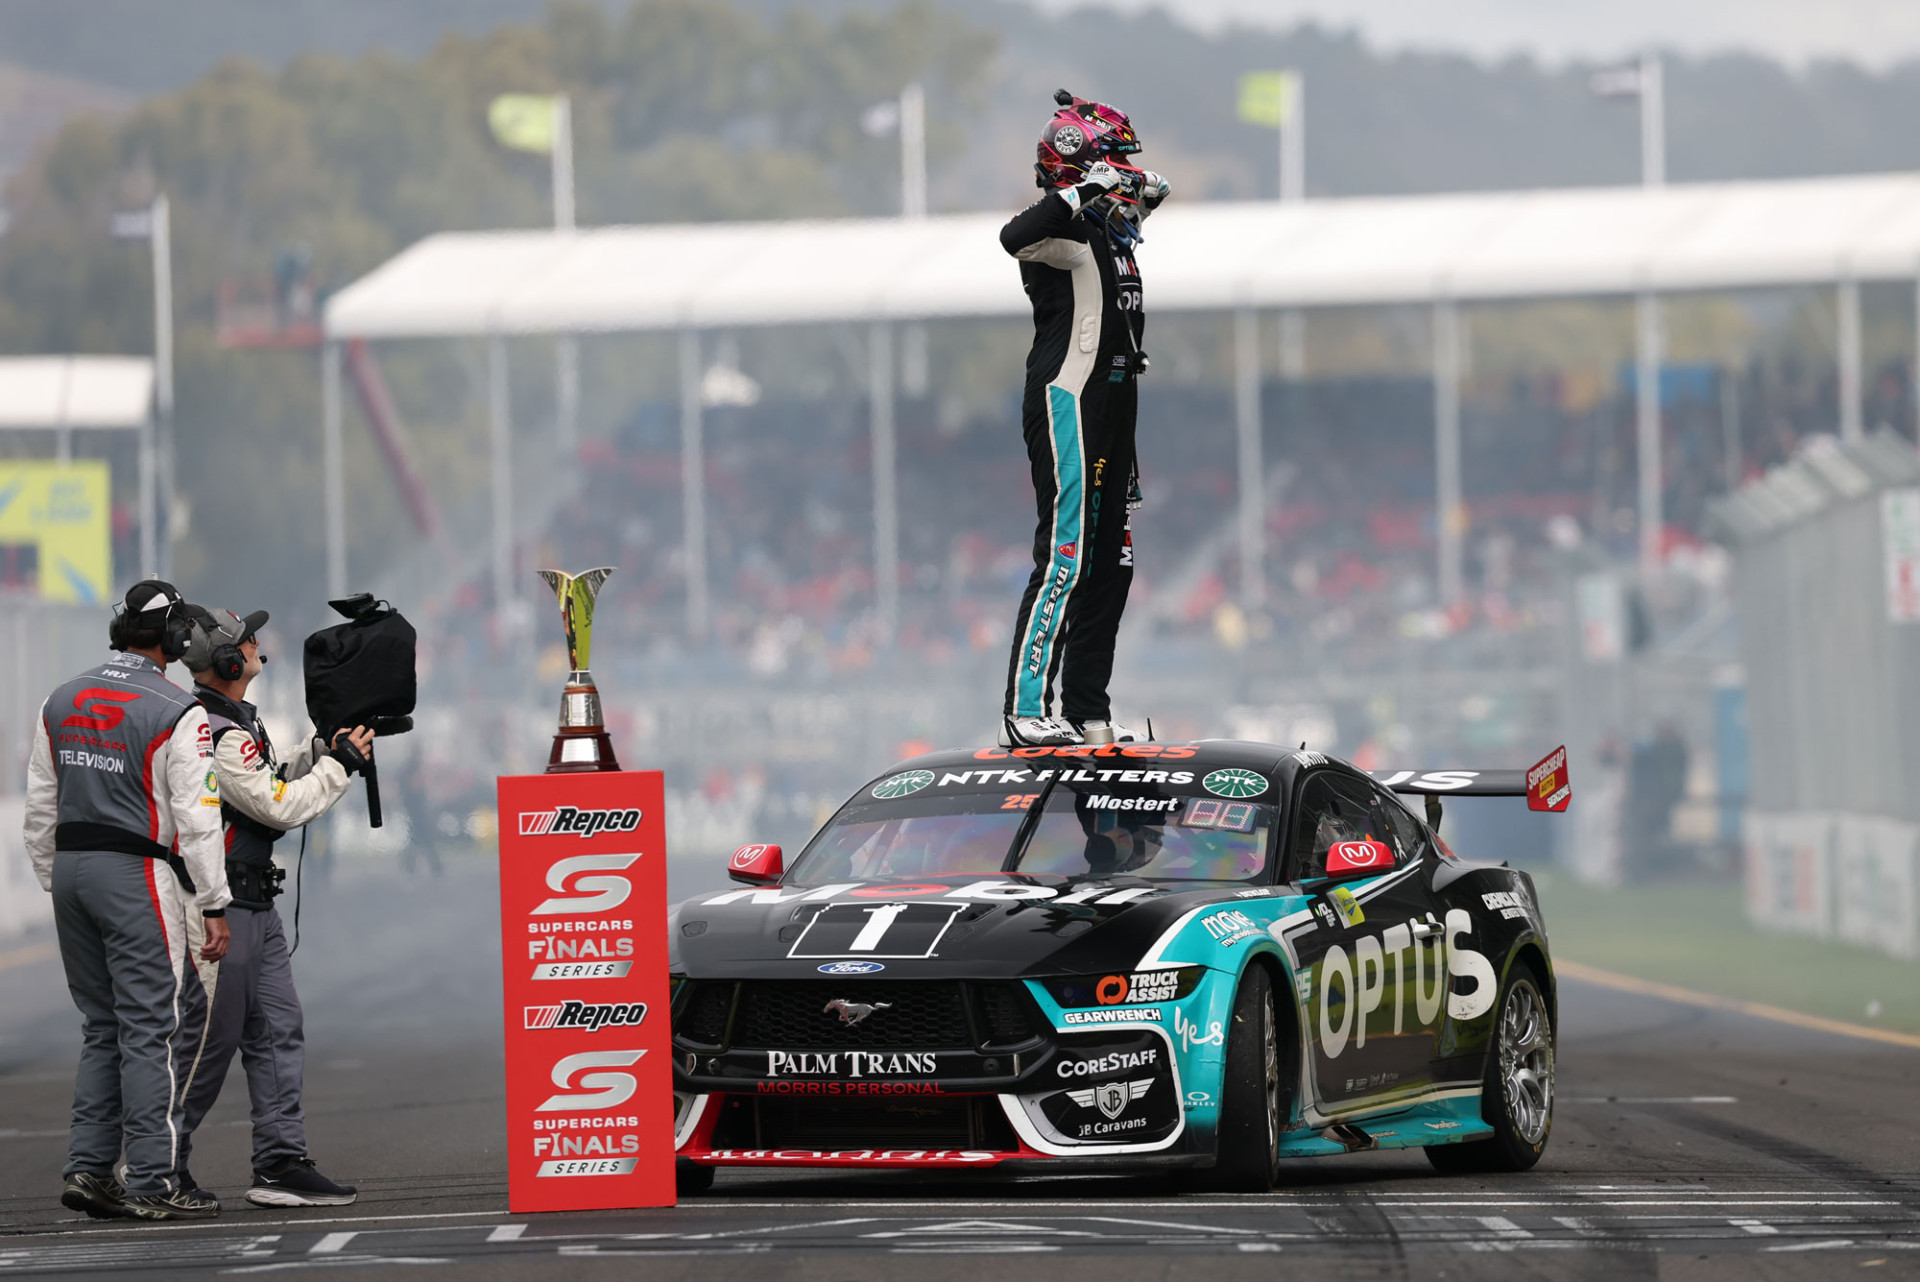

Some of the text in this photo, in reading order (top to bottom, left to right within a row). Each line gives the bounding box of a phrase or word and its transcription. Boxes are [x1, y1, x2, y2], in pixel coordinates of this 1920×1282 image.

[59, 750, 124, 773] TELEVISION
[938, 769, 1195, 786] NTK FILTERS
[1214, 775, 1259, 787] NTK
[1001, 794, 1040, 809] 25
[1086, 795, 1178, 811] Mostert
[552, 806, 643, 835] Repco
[528, 920, 634, 934] SUPERCARS
[528, 936, 634, 960] FINALS
[548, 964, 616, 978] SERIES
[831, 964, 872, 974] Ford
[1130, 971, 1179, 989] TRUCK
[1319, 909, 1498, 1059] OPTUS
[1125, 985, 1178, 1003] ASSIST
[557, 1001, 648, 1031] Repco
[1064, 1009, 1162, 1024] GEARWRENCH
[766, 1051, 937, 1077] PALM TRANS
[757, 1081, 945, 1094] MORRIS PERSONAL
[533, 1116, 639, 1130] SUPERCARS
[1094, 1117, 1147, 1134] Caravans
[534, 1133, 640, 1157] FINALS
[554, 1160, 622, 1175] SERIES
